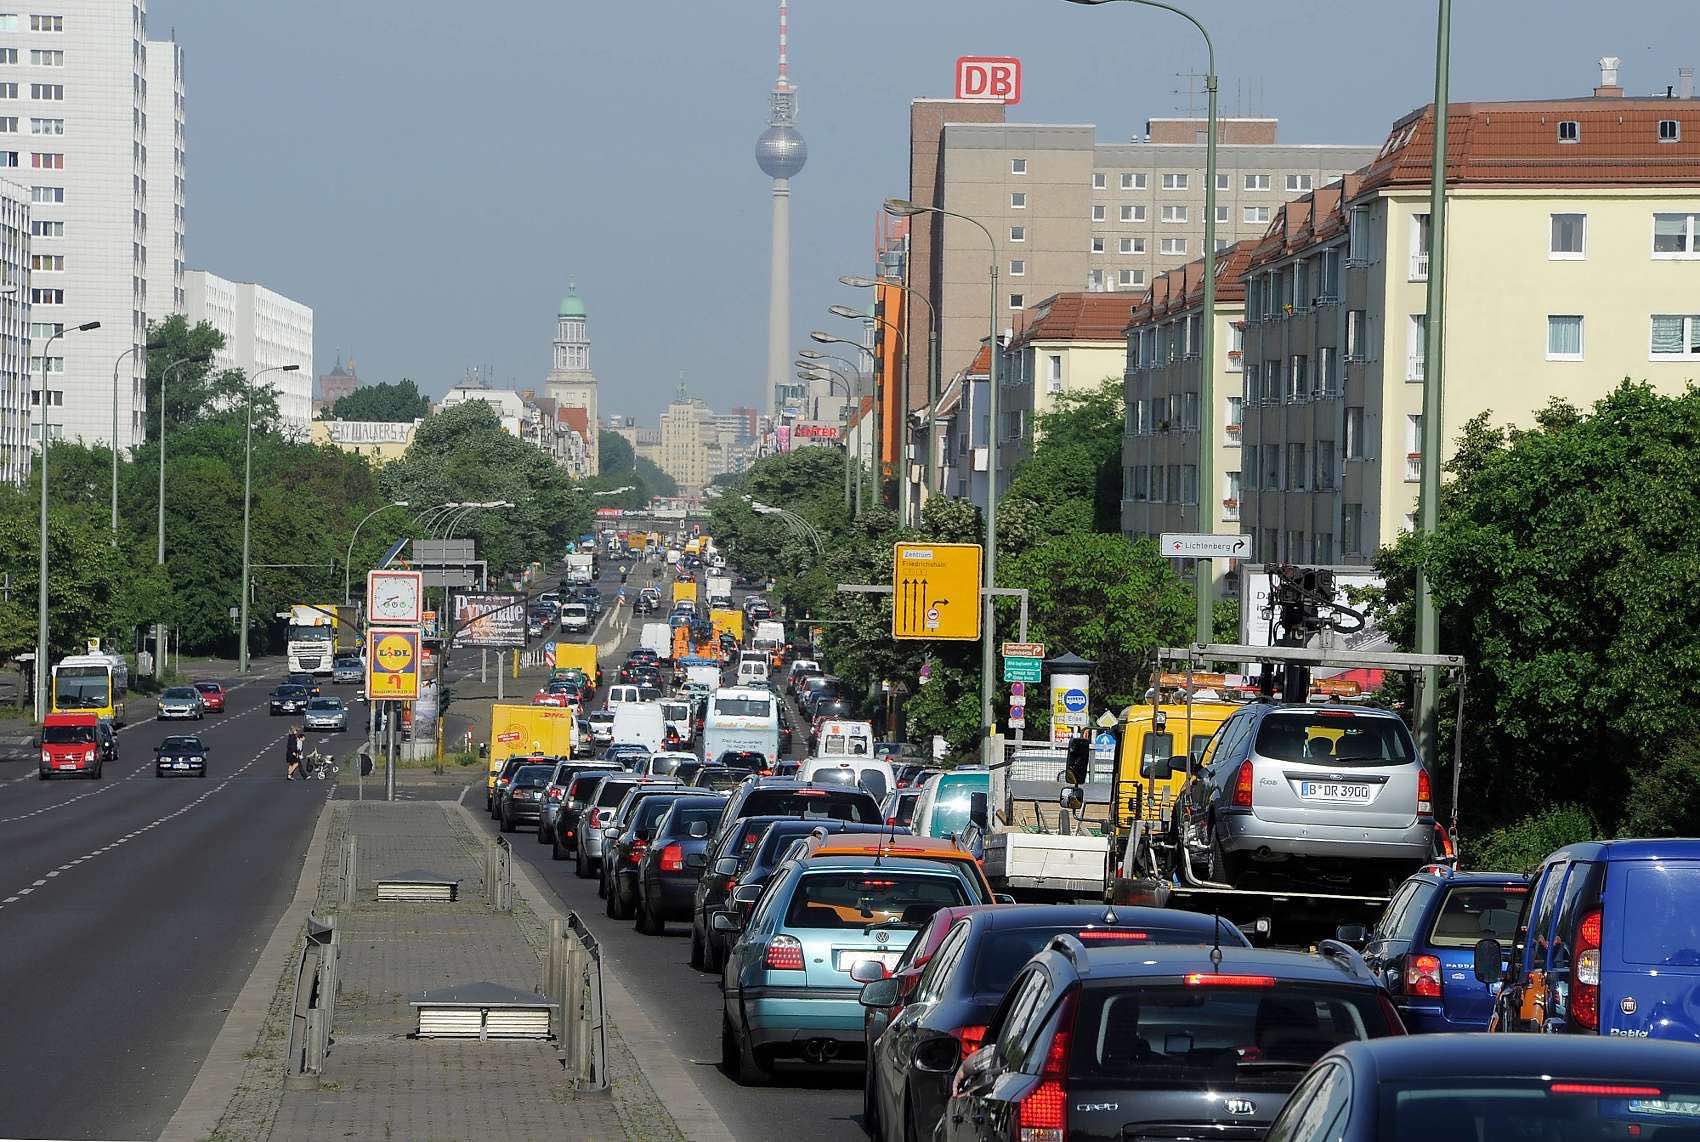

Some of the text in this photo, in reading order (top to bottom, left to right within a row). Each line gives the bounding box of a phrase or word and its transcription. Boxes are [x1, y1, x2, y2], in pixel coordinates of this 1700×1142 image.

[966, 66, 1012, 95] DB
[332, 423, 397, 440] SKYWALKERS
[1185, 542, 1231, 551] Lichtenberg
[1228, 1100, 1253, 1115] KIA
